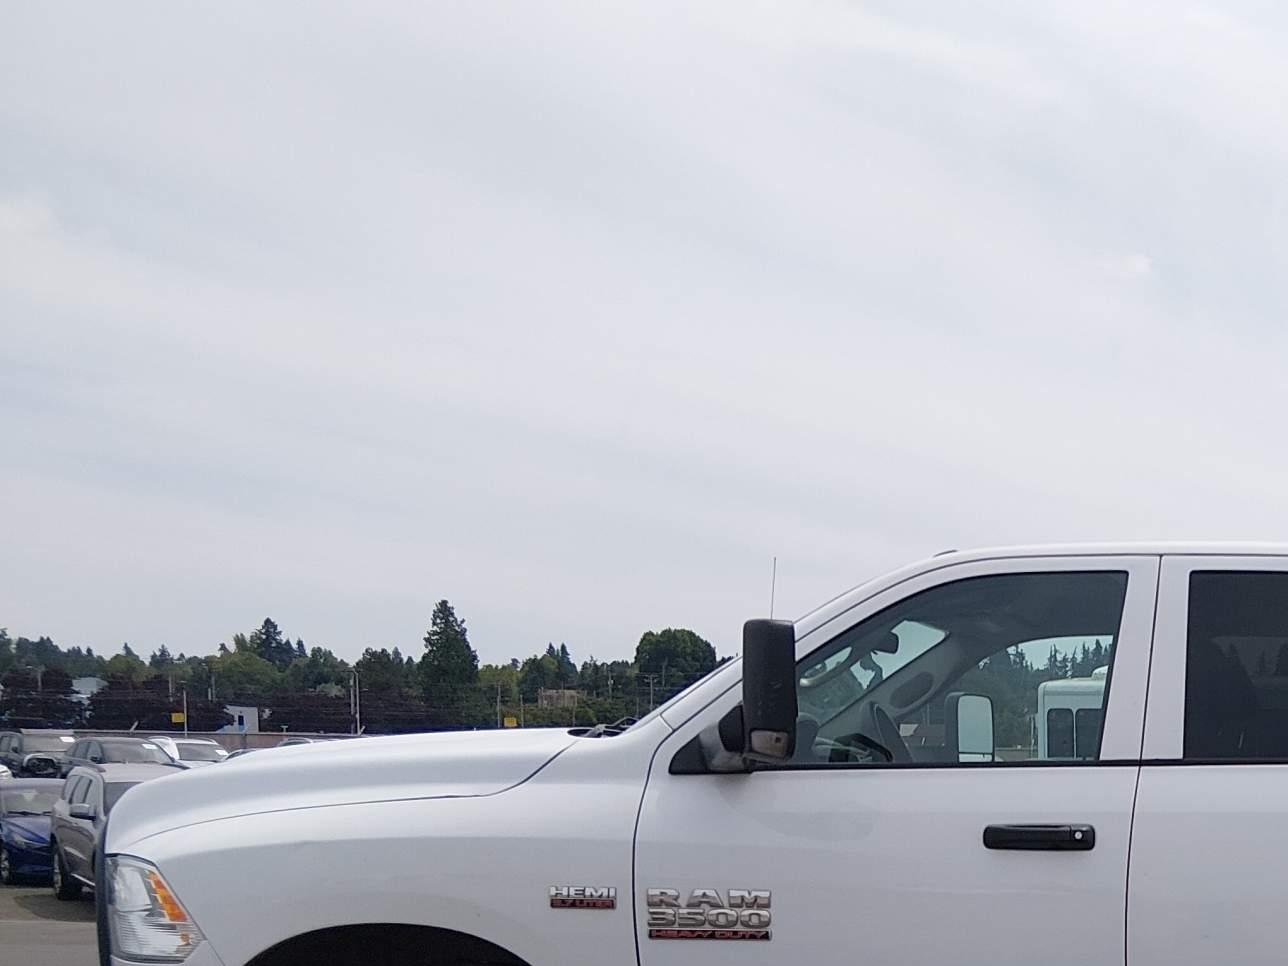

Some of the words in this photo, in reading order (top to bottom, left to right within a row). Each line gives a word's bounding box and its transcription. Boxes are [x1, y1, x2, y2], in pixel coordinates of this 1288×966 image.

[550, 886, 616, 898] HEMI
[647, 888, 771, 908] RAM
[648, 908, 771, 928] 3500
[651, 930, 712, 939] HEAVY
[715, 931, 767, 939] DUTY
